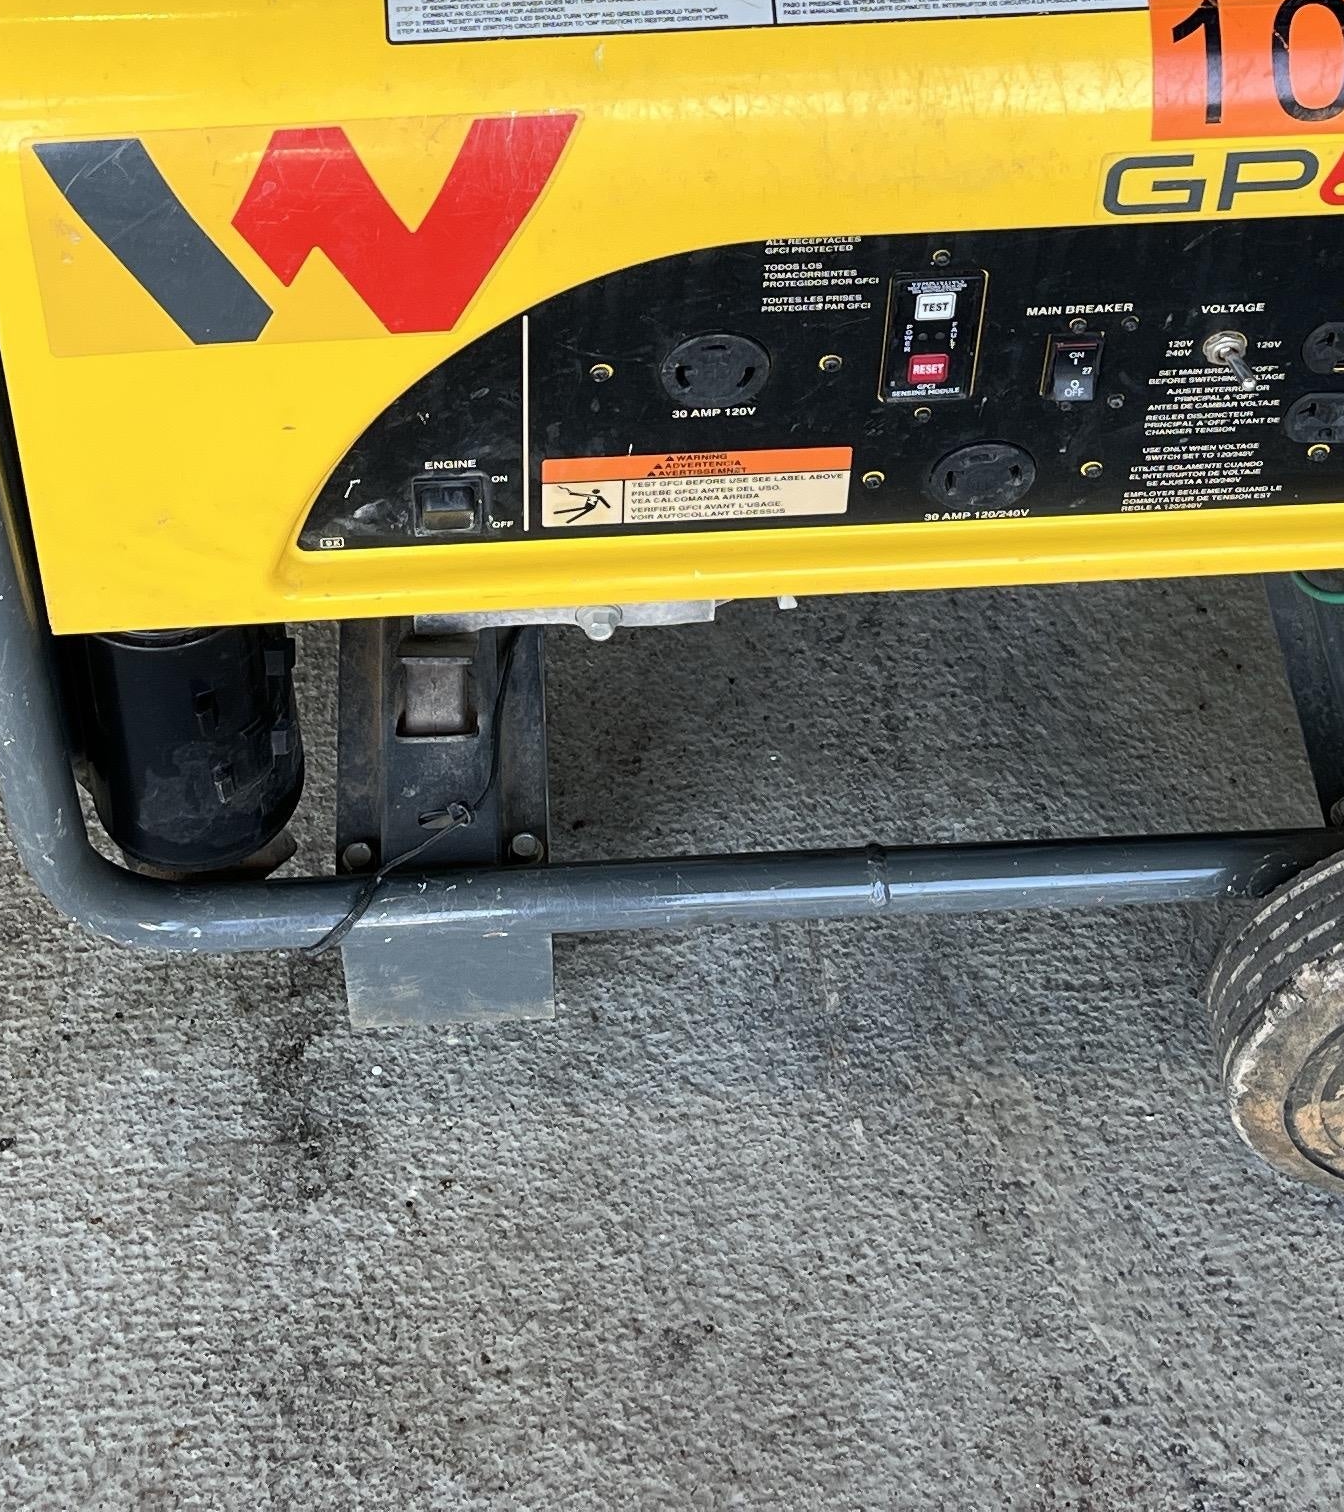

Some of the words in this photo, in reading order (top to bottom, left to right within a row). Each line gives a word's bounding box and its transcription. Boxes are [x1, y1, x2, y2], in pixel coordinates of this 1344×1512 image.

[787, 236, 862, 245] RECEPTACLES
[791, 245, 854, 253] PROTECTED
[764, 263, 799, 271] TODOS
[763, 269, 857, 279] TOMACORRIENTES
[762, 279, 828, 288] PROTEGIDOS
[830, 278, 852, 286] POR
[854, 277, 879, 285] GFCI
[762, 296, 801, 304] TOUTES
[825, 294, 862, 302] PRISES
[761, 304, 823, 312] PROTEGEES
[923, 303, 949, 312] TEST
[1026, 306, 1061, 316] MAIN
[1065, 303, 1134, 314] BREAKER
[1200, 302, 1266, 314] VOLTAGE
[1168, 340, 1194, 348] 120V
[1257, 340, 1282, 348] 120V
[1165, 349, 1192, 357] 240V
[912, 364, 944, 374] RESET
[1082, 367, 1092, 375] 27
[1189, 376, 1238, 384] SWITCHIN
[892, 389, 925, 397] SENSING
[927, 387, 960, 395] MODULE
[1064, 388, 1085, 397] OFF
[1147, 403, 1178, 411] ANTES
[1180, 402, 1192, 410] DE
[1194, 401, 1237, 409] CAMBIAR
[1240, 399, 1280, 407] VOLTAJE
[671, 409, 687, 419] 30
[690, 408, 720, 418] AMP
[724, 407, 756, 417] 120V
[1145, 428, 1192, 436] CHANGER
[1194, 426, 1236, 434] TENSION
[1162, 445, 1187, 453] ONLY
[1188, 444, 1216, 452] WHEN
[1218, 442, 1259, 451] VOLTAGE
[676, 453, 728, 462] WARNING
[1144, 453, 1180, 461] SWITCH
[1182, 452, 1199, 460] SET
[424, 459, 477, 470] ENGINE
[665, 460, 742, 469] ADVERTENCIA
[491, 475, 508, 483] ON
[685, 478, 725, 486] BEFORE
[774, 474, 805, 482] LABEL
[808, 473, 844, 481] ABOVE
[700, 486, 733, 494] ANTES
[631, 505, 675, 513] VERIFIER
[704, 502, 735, 510] AVANT
[656, 510, 729, 519] AUTOCOLLANT
[732, 508, 786, 516] CI-DESSUS
[923, 511, 938, 522] 30
[942, 509, 970, 521] AMP
[974, 507, 1030, 520] 120/240V
[492, 520, 514, 529] OFF
